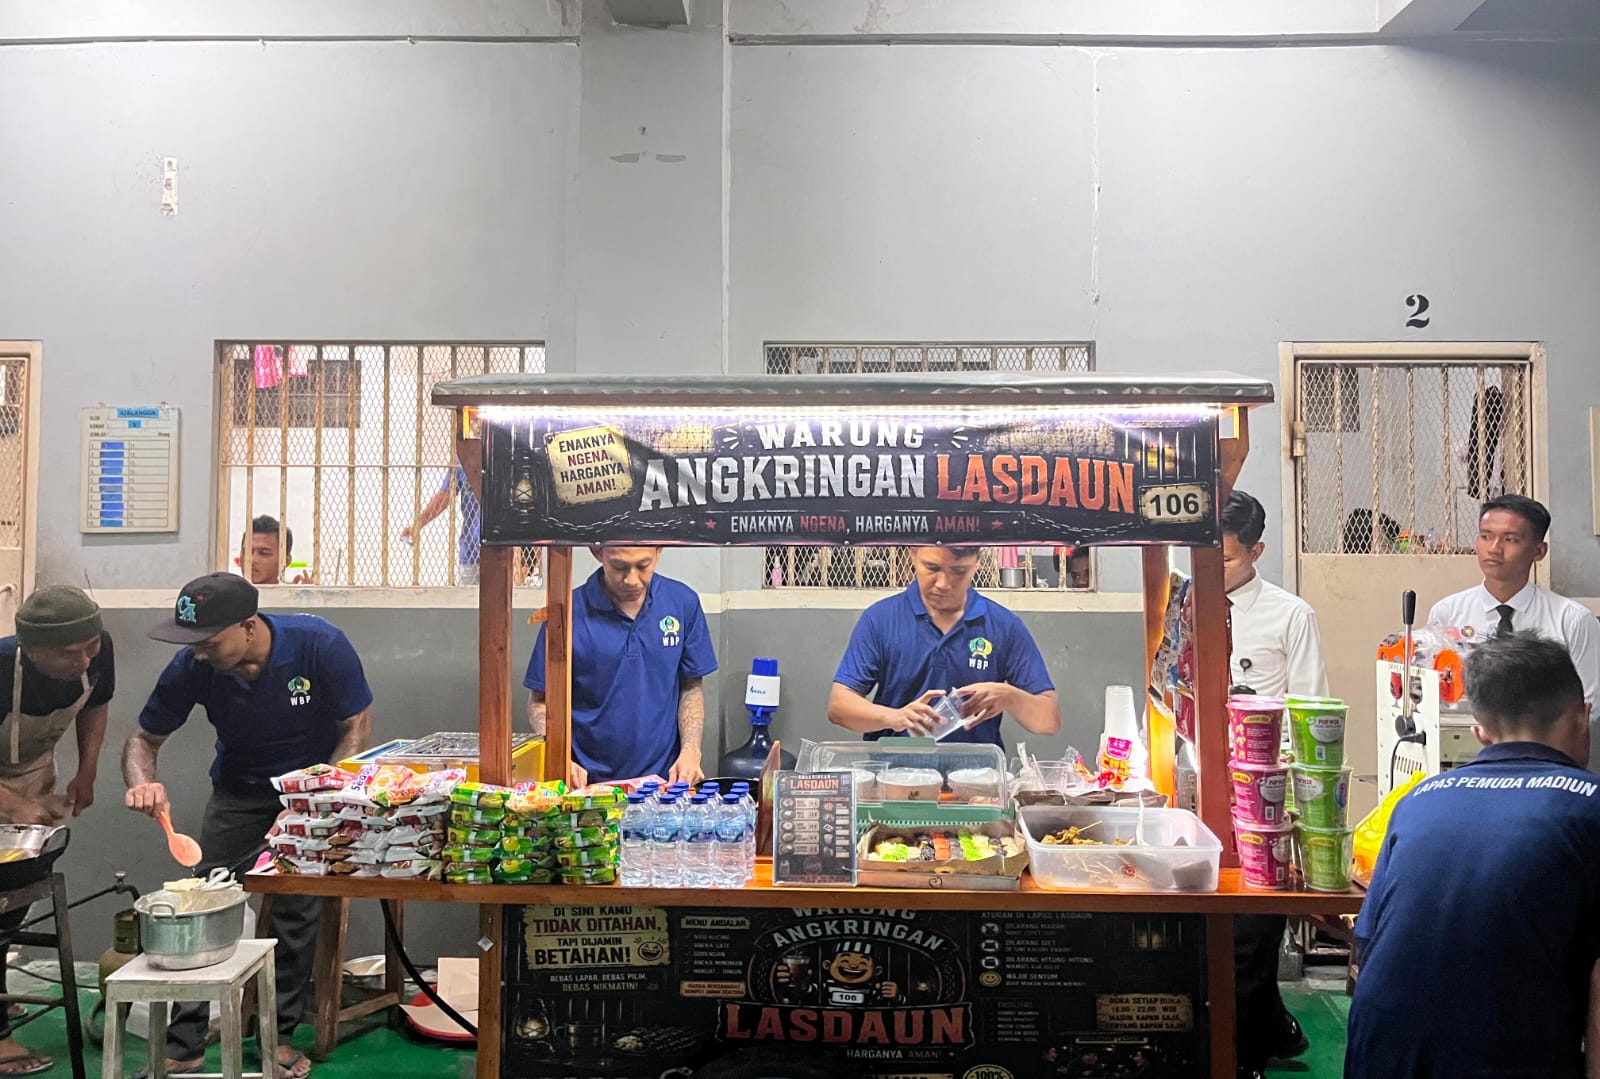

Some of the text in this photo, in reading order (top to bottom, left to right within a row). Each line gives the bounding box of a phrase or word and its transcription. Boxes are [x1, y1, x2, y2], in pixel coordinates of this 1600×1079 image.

[1405, 294, 1430, 328] 2
[559, 433, 615, 453] ENAKNYA
[756, 420, 925, 449] WARUNG
[567, 450, 613, 467] NGENA,
[560, 462, 625, 483] HARGANYA
[576, 479, 617, 497] AMAN!
[639, 454, 1135, 514] ANGKRINGAN LASDAUN
[1150, 493, 1199, 516] 106
[731, 516, 980, 535] ENAKNYA NGENA, HARGANYA AMAN!
[790, 779, 839, 789] LASDAUN
[1413, 776, 1597, 797] LAPAS PEMUDA MADIUN
[554, 906, 632, 916] DI SINI KAMU
[533, 917, 661, 933] TIDAK DITAHAN,
[772, 919, 945, 950] ANGKRINGAN
[557, 937, 622, 946] TAPI DIJAMIN
[535, 947, 631, 965] BETAHAN!
[726, 1003, 965, 1044] LASDAUN
[846, 1050, 904, 1059] HARGANYA
